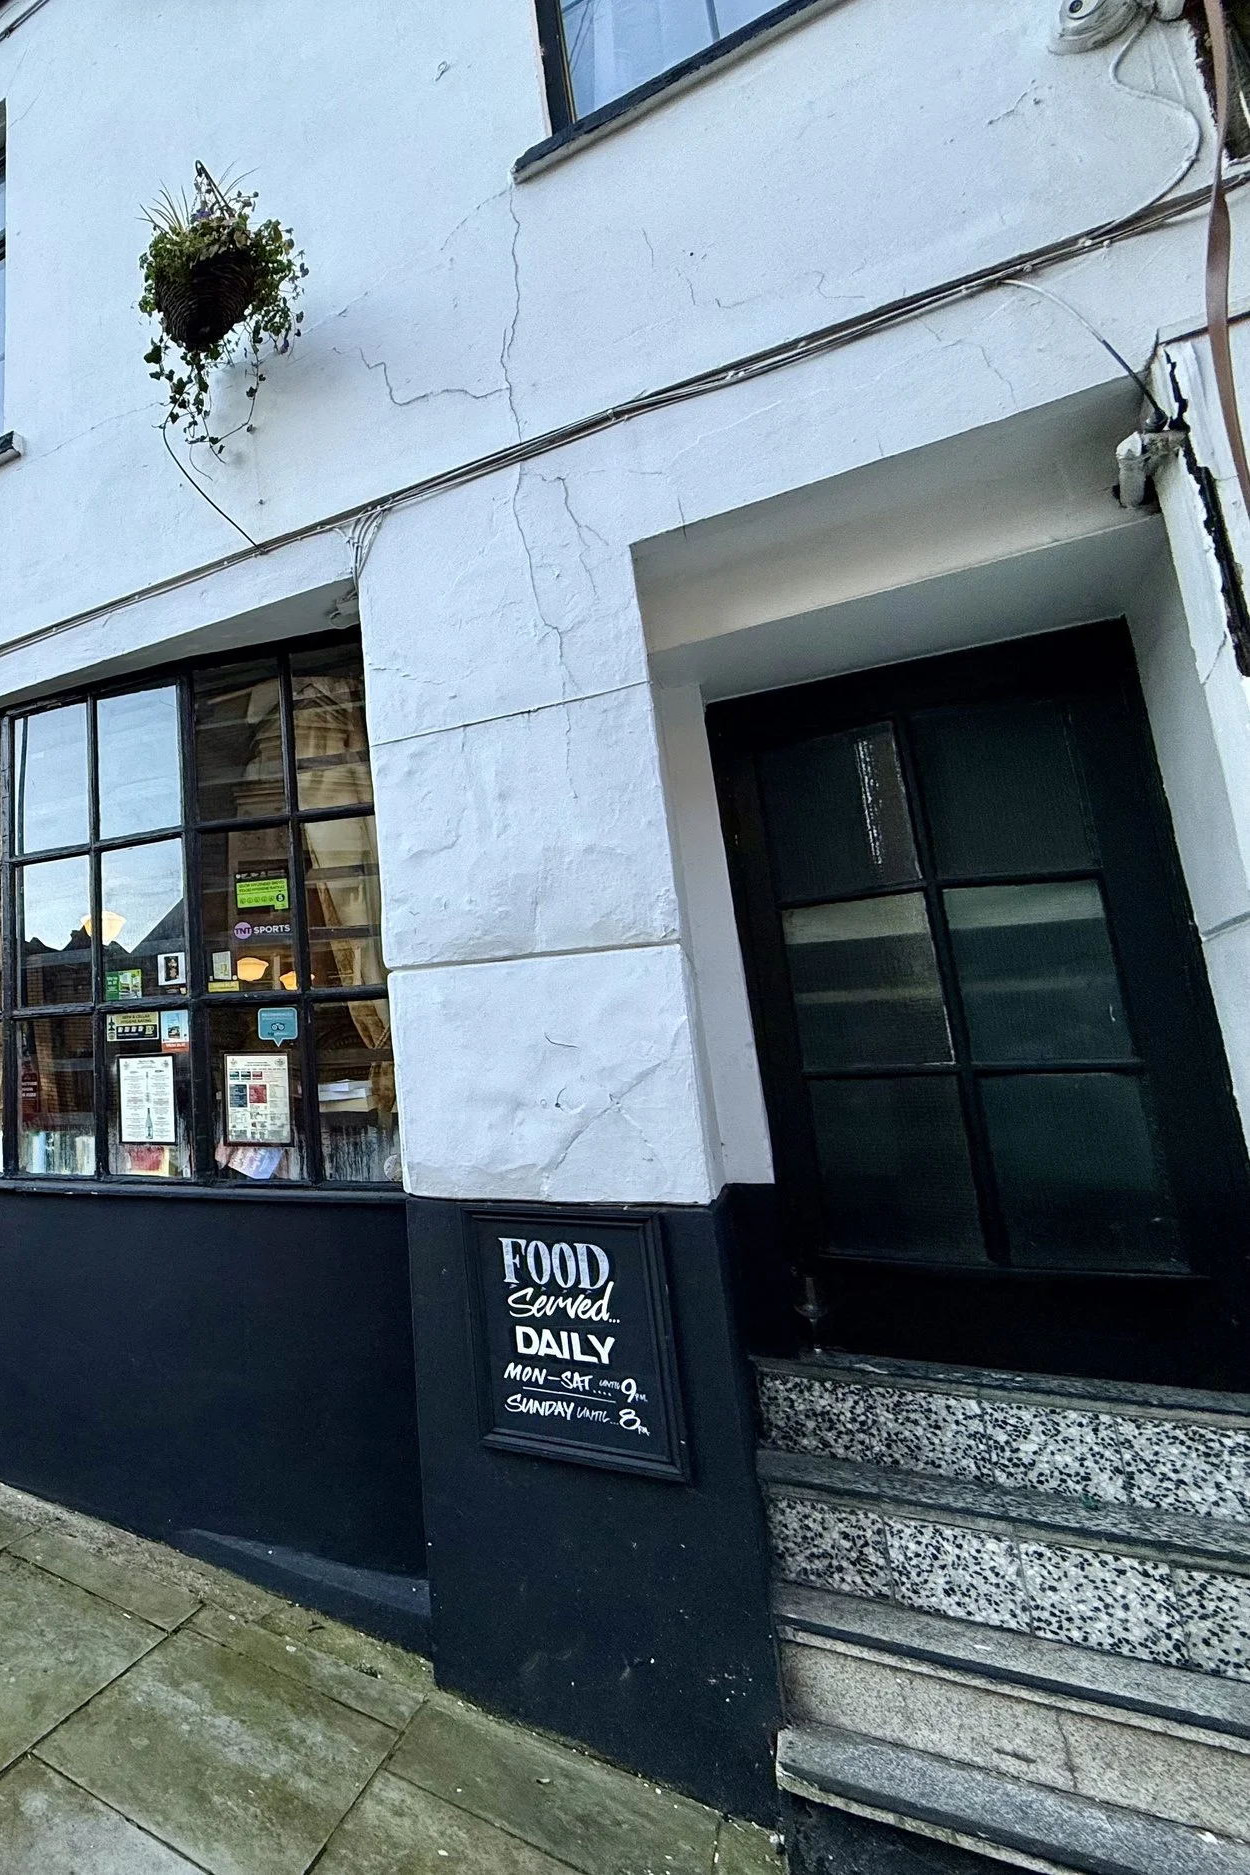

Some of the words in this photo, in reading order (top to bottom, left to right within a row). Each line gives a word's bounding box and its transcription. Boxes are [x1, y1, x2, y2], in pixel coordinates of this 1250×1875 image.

[254, 924, 291, 934] SPORTS
[498, 1237, 610, 1290] FOOD
[515, 1325, 615, 1364] DAILY
[504, 1393, 575, 1421] SUNDAY
